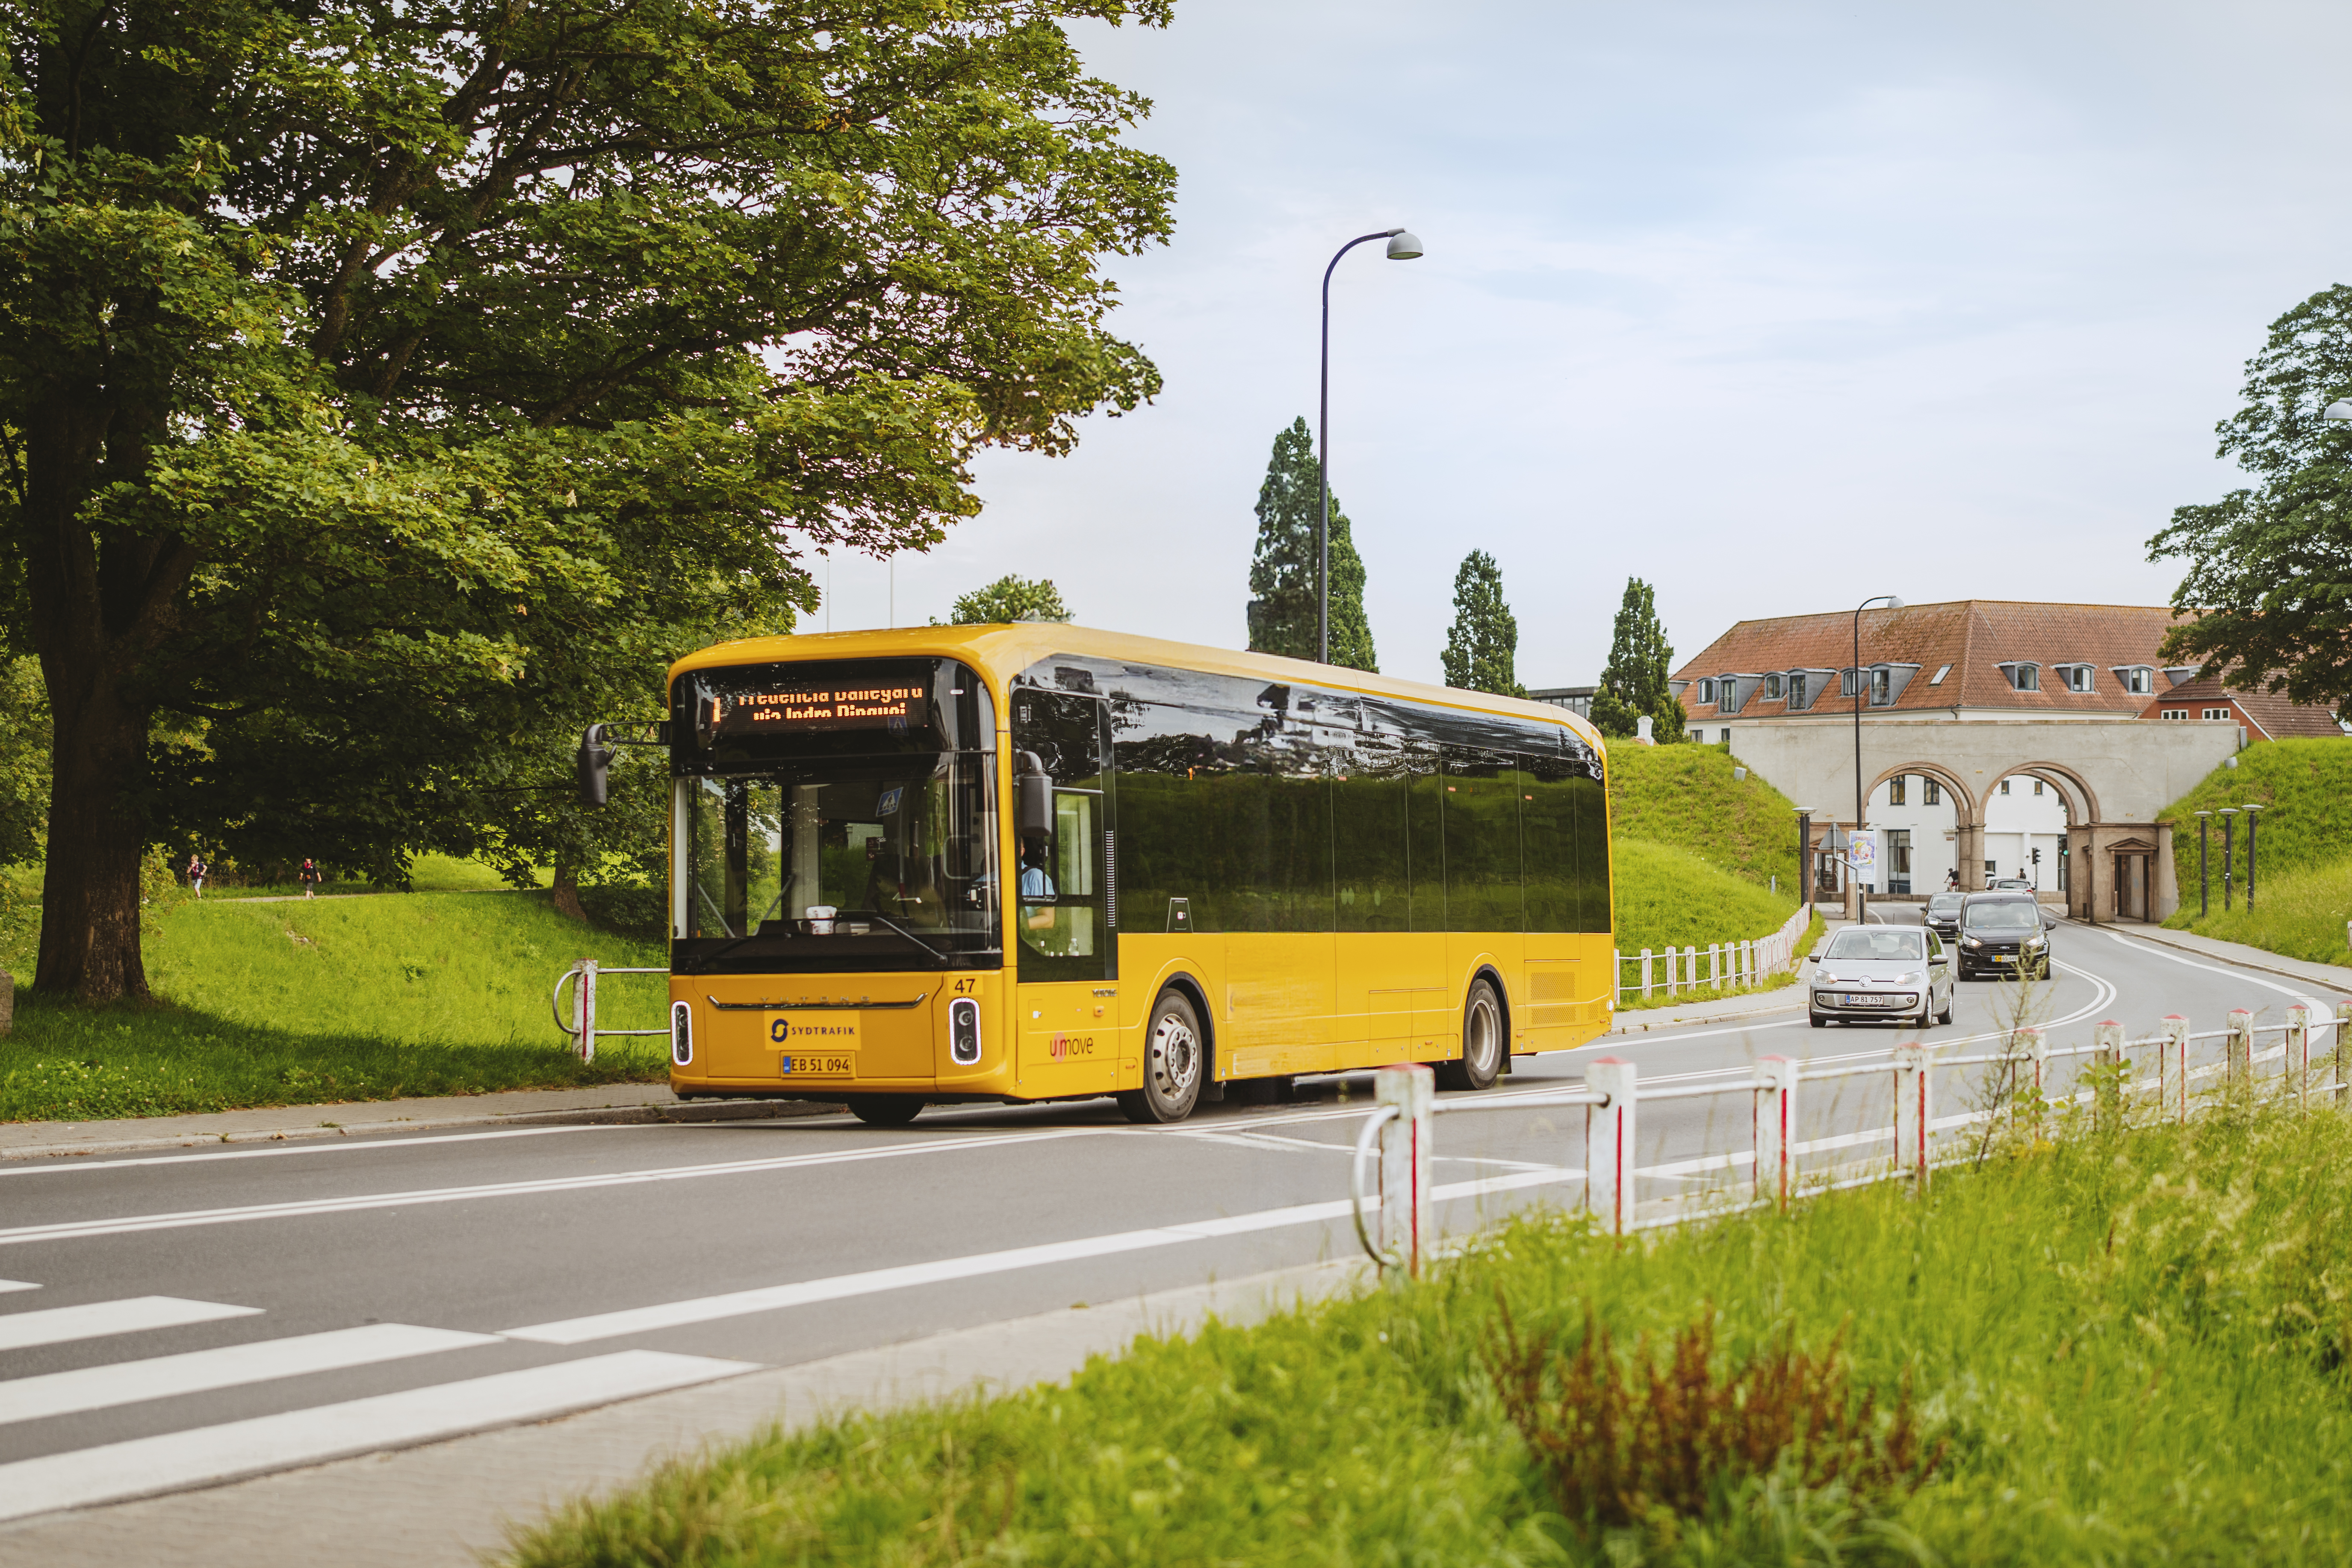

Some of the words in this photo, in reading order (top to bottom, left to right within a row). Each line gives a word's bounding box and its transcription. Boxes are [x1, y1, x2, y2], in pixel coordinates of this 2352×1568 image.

[955, 978, 975, 993] 47
[1092, 988, 1117, 998] YUTONG
[792, 1026, 855, 1035] SYDTRAFIK
[792, 1058, 807, 1071] EB
[810, 1058, 823, 1071] 51
[827, 1058, 849, 1071] 094
